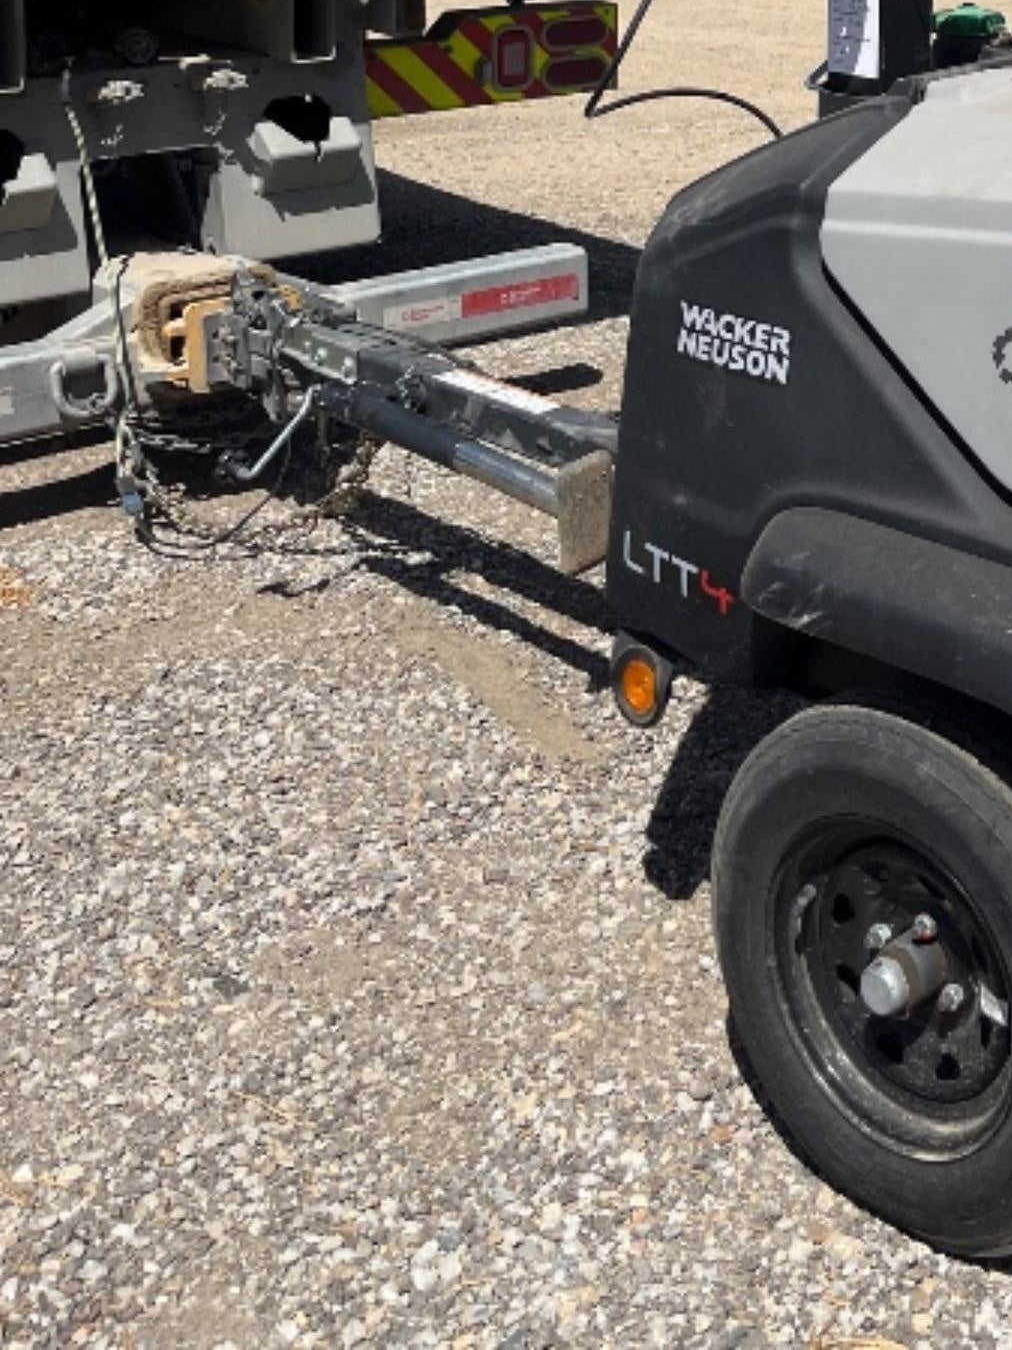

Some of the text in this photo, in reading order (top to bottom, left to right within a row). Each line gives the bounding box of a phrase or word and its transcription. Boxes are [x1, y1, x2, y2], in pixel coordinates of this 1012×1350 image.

[680, 300, 792, 355] WACKER
[677, 328, 790, 385] NEUSON
[623, 530, 734, 615] LTT4
